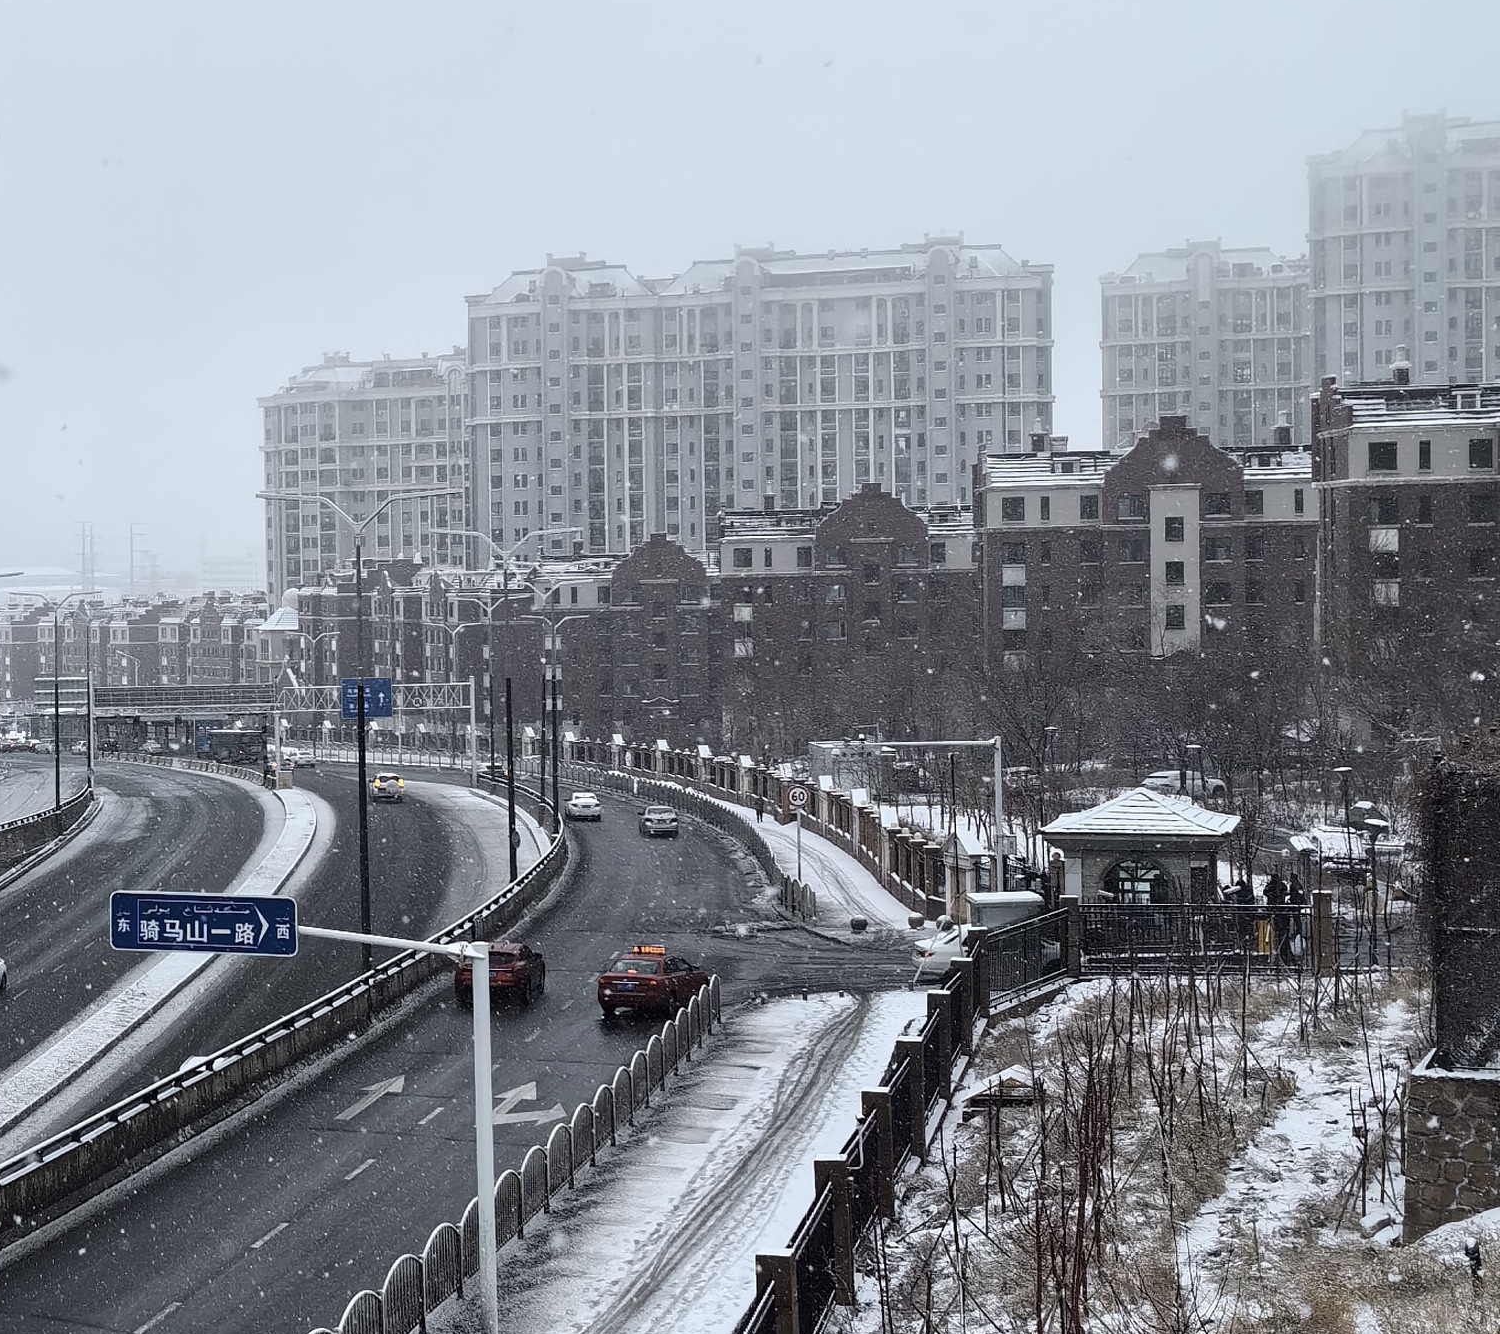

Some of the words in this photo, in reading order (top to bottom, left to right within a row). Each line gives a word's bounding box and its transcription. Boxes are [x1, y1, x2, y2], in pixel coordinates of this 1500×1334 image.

[791, 791, 806, 802] 60
[116, 916, 131, 933] 东
[139, 918, 255, 945] 骑马山一路
[274, 922, 291, 940] 西
